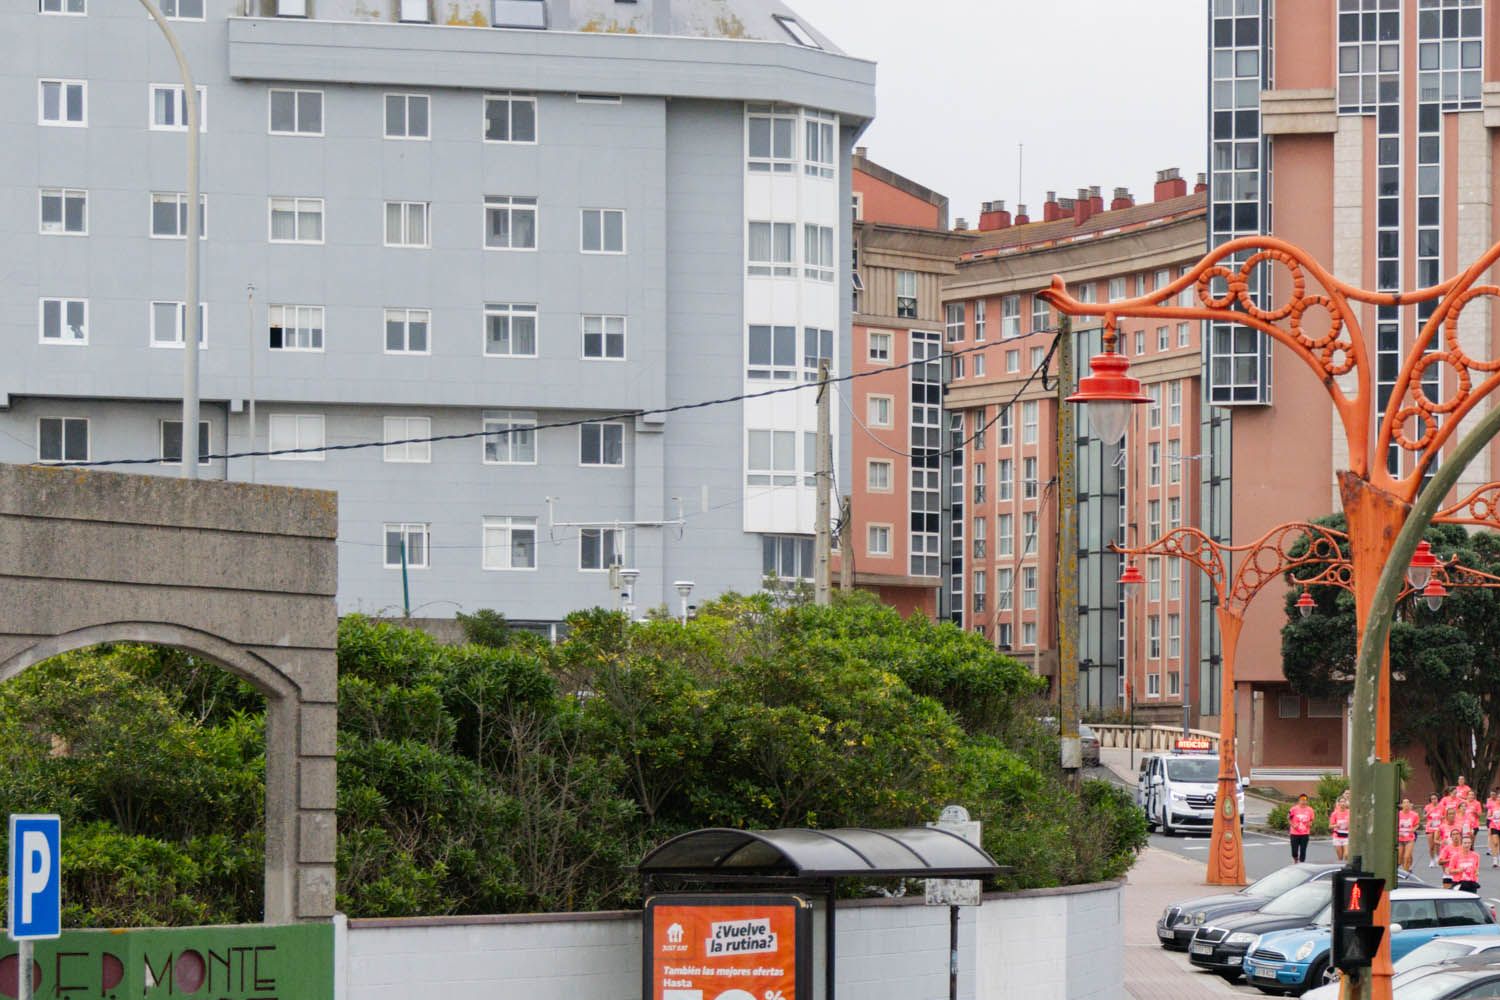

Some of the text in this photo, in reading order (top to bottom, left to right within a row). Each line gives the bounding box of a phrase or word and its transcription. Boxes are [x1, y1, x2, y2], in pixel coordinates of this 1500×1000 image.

[22, 831, 51, 924] P
[715, 922, 766, 939] ¿Vuelve
[710, 935, 774, 953] la rutina?
[143, 945, 276, 998] MONTE
[663, 965, 785, 977] También las mejores ofertas
[663, 978, 693, 987] Hasta
